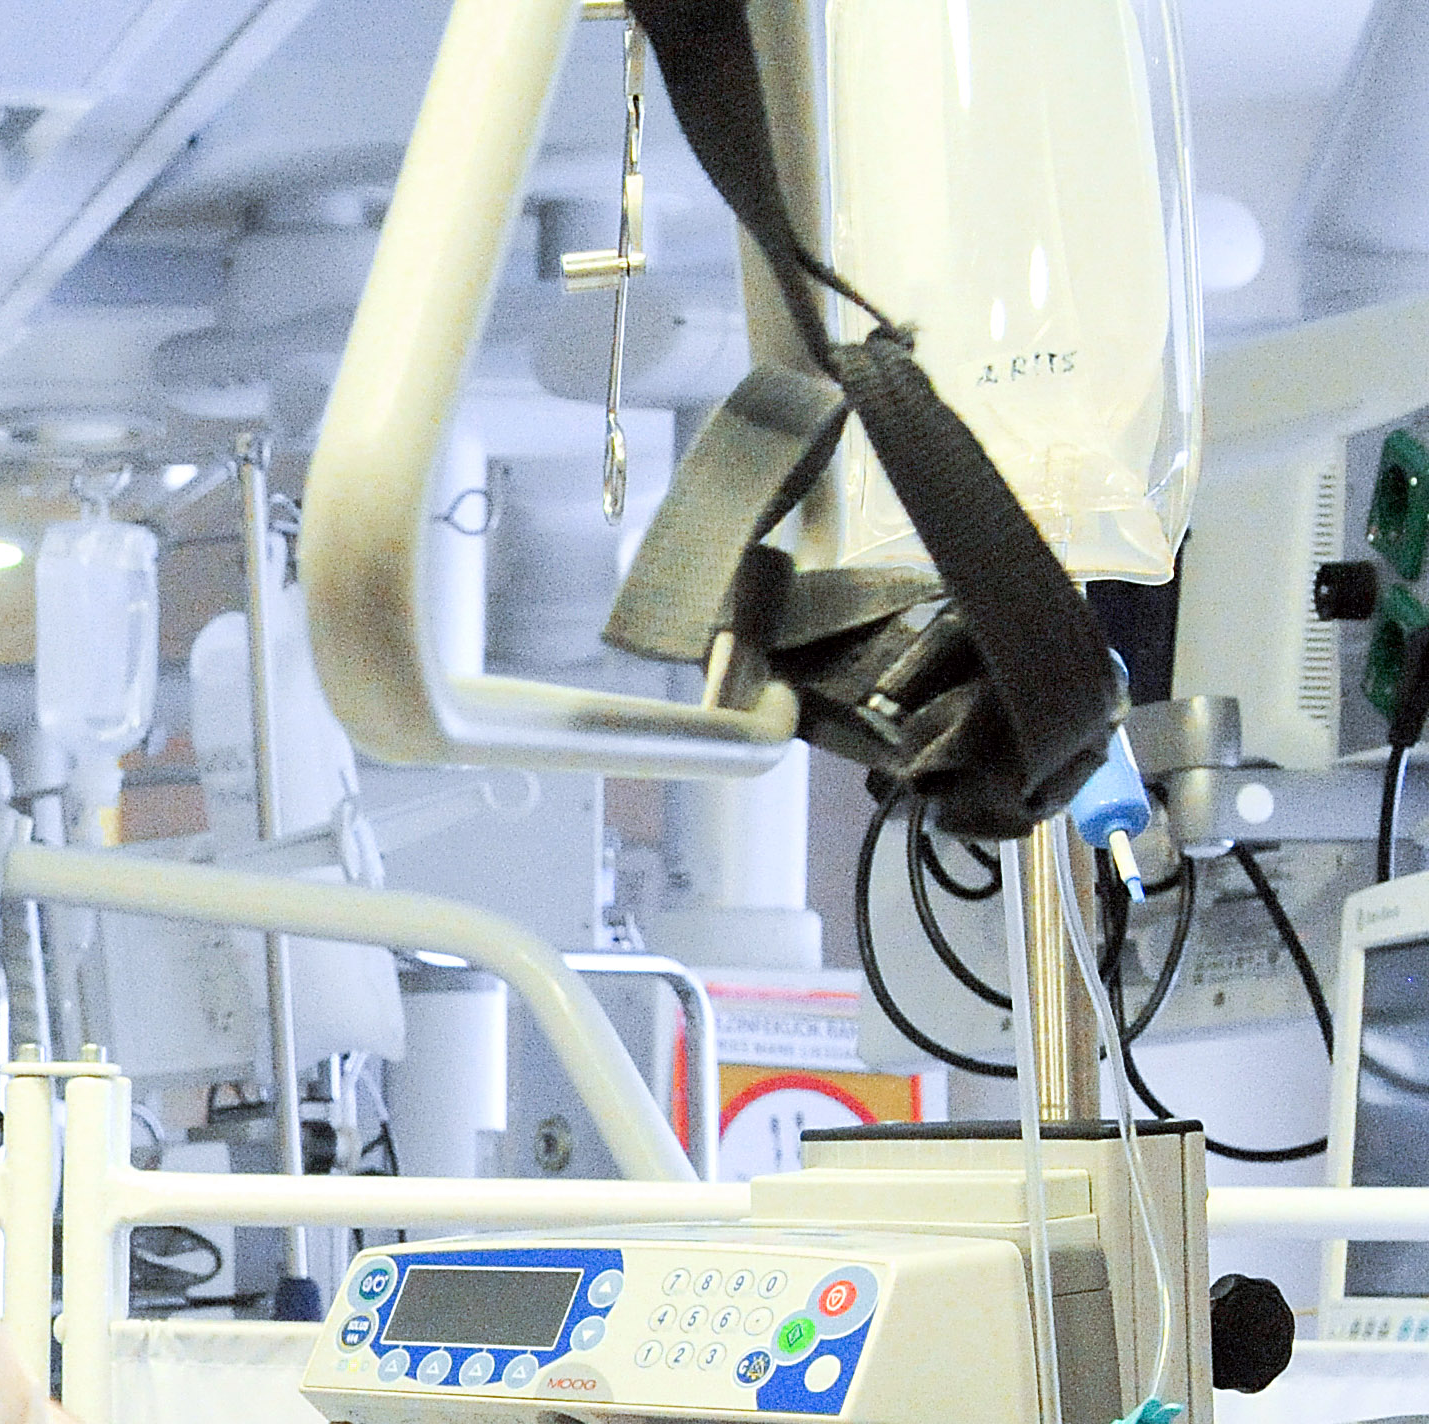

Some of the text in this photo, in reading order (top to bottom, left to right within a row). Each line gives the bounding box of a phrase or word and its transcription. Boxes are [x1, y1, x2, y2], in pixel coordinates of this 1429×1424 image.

[669, 1273, 778, 1293] 7 8 9 0
[657, 1310, 732, 1329] 4 5 6
[643, 1346, 718, 1365] 1 2 3
[547, 1377, 597, 1391] MOOG
